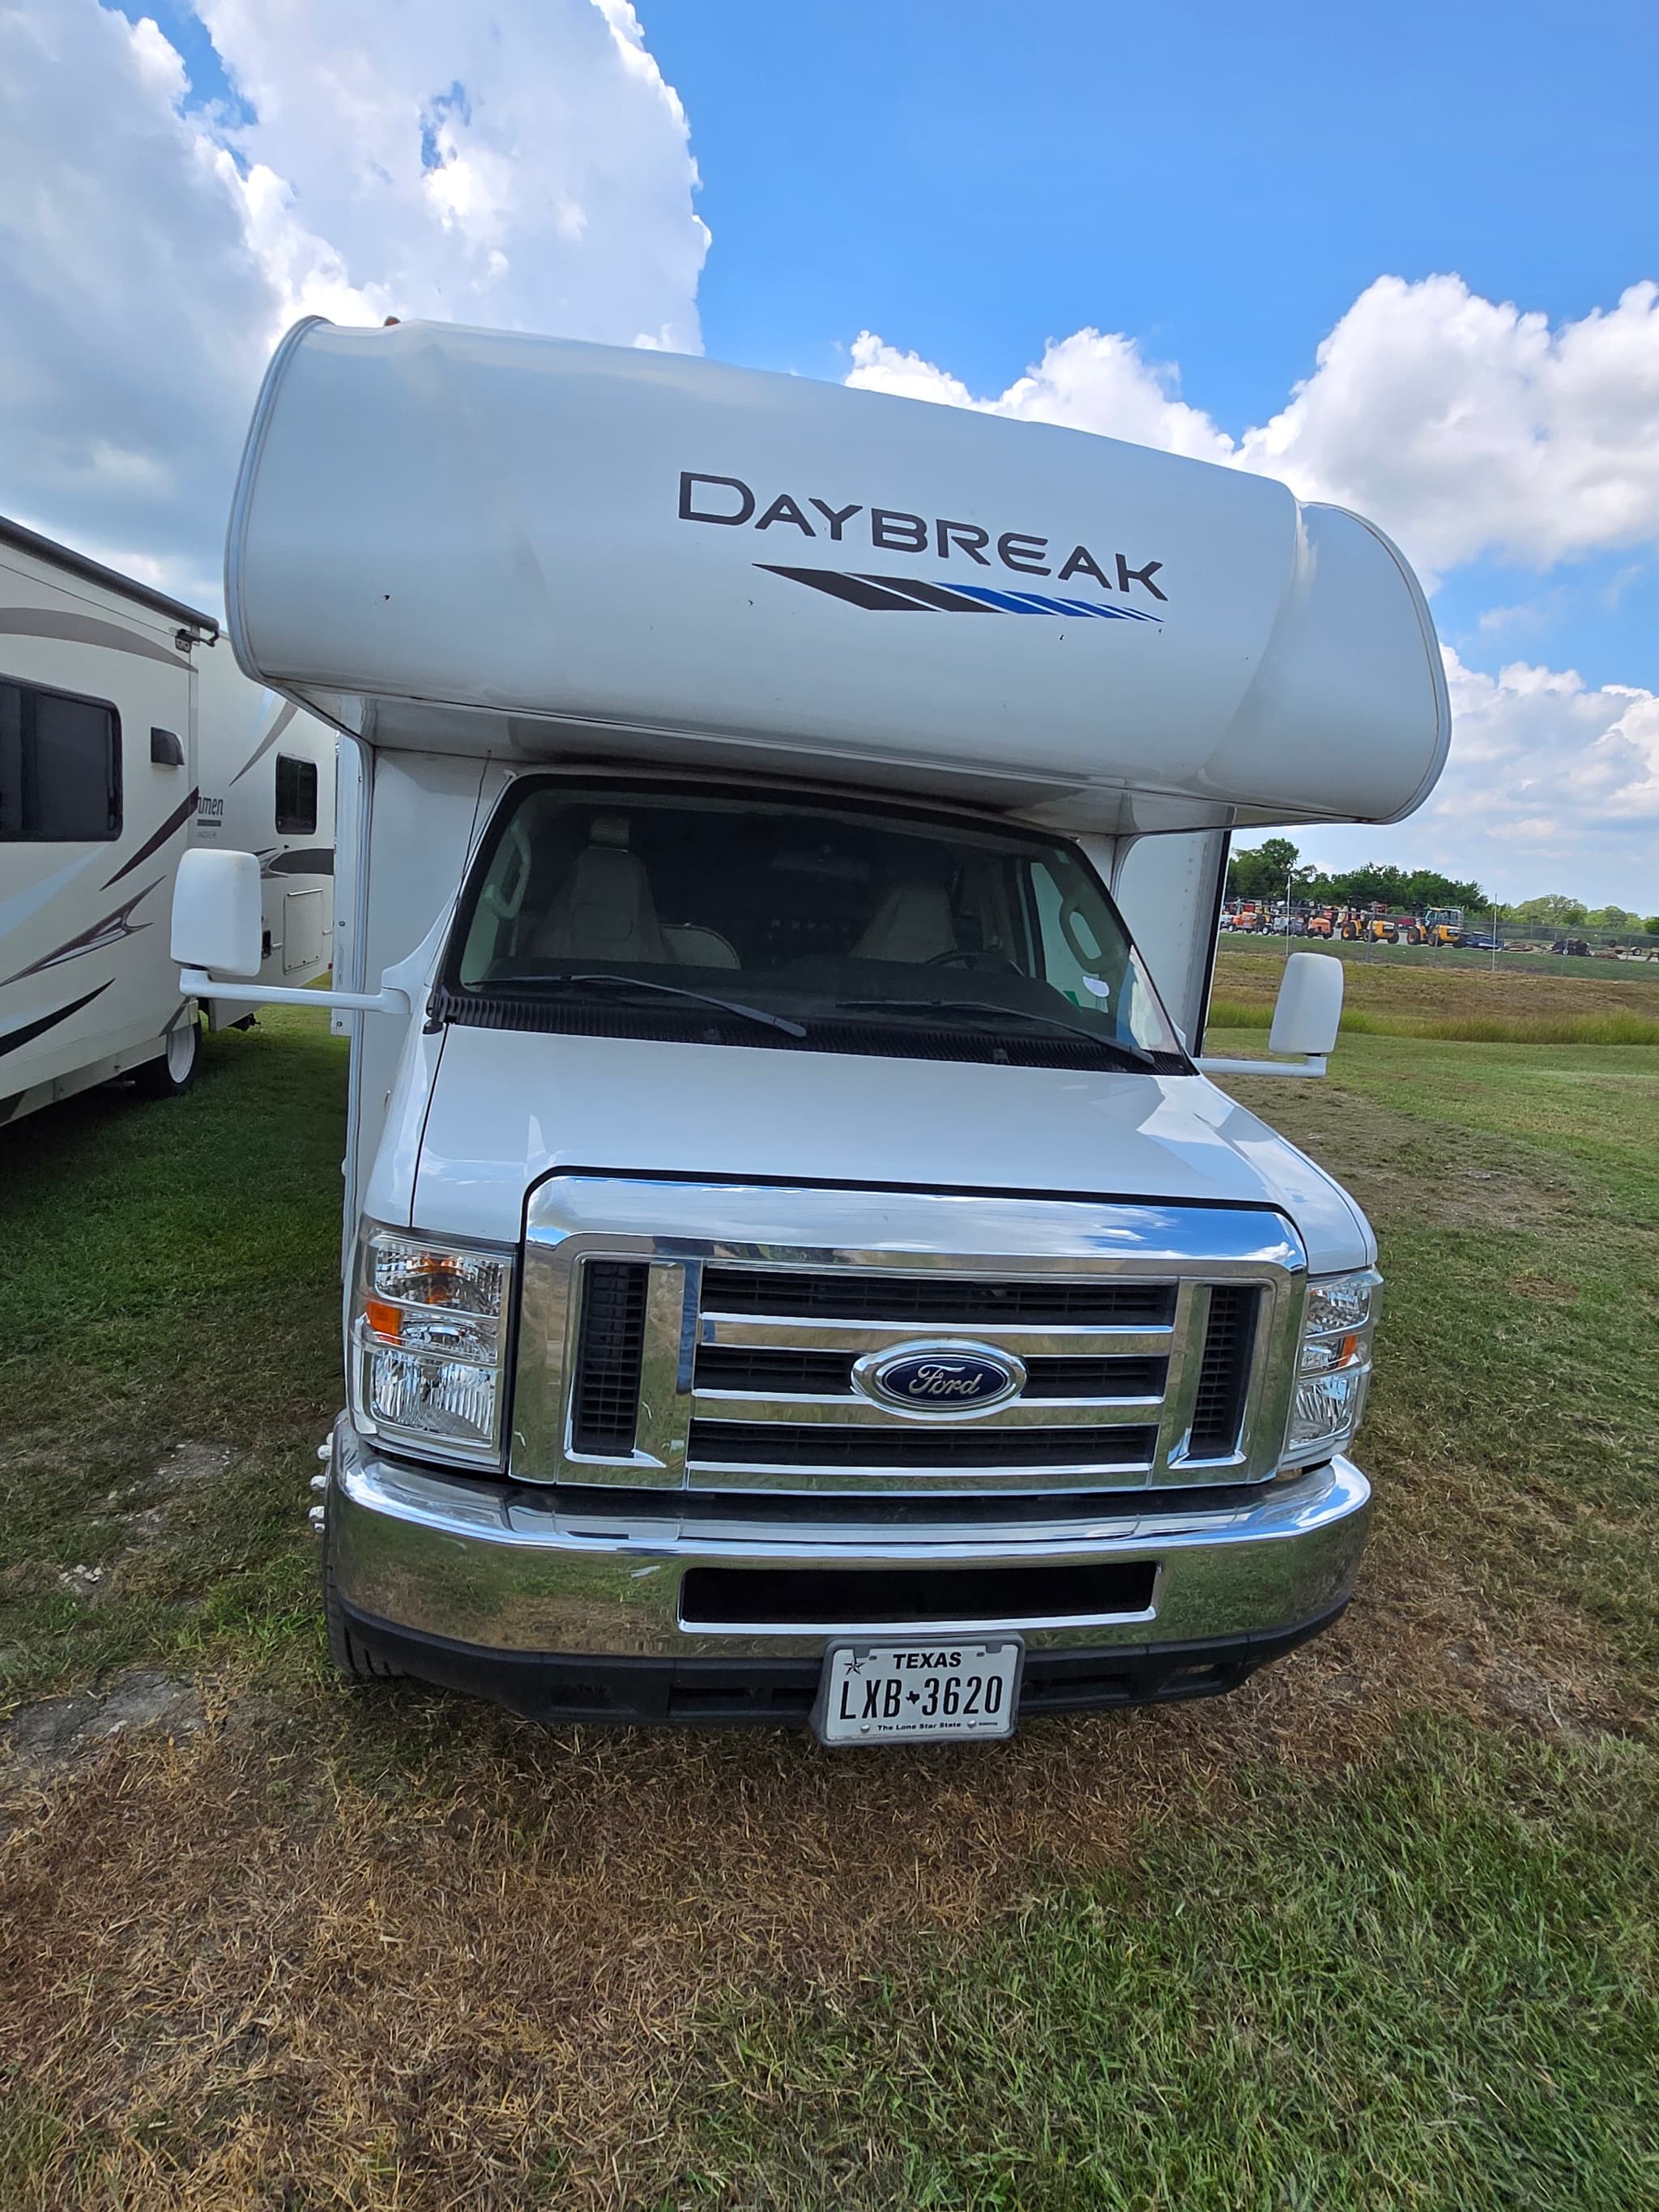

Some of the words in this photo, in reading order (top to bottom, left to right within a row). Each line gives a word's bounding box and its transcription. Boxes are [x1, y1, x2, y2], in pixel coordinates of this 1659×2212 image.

[679, 471, 1168, 601] DAYBREAK
[908, 1365, 983, 1395] Ford
[893, 1652, 962, 1669] TEXAS
[839, 1679, 902, 1720] LXB
[922, 1676, 1003, 1716] 3620
